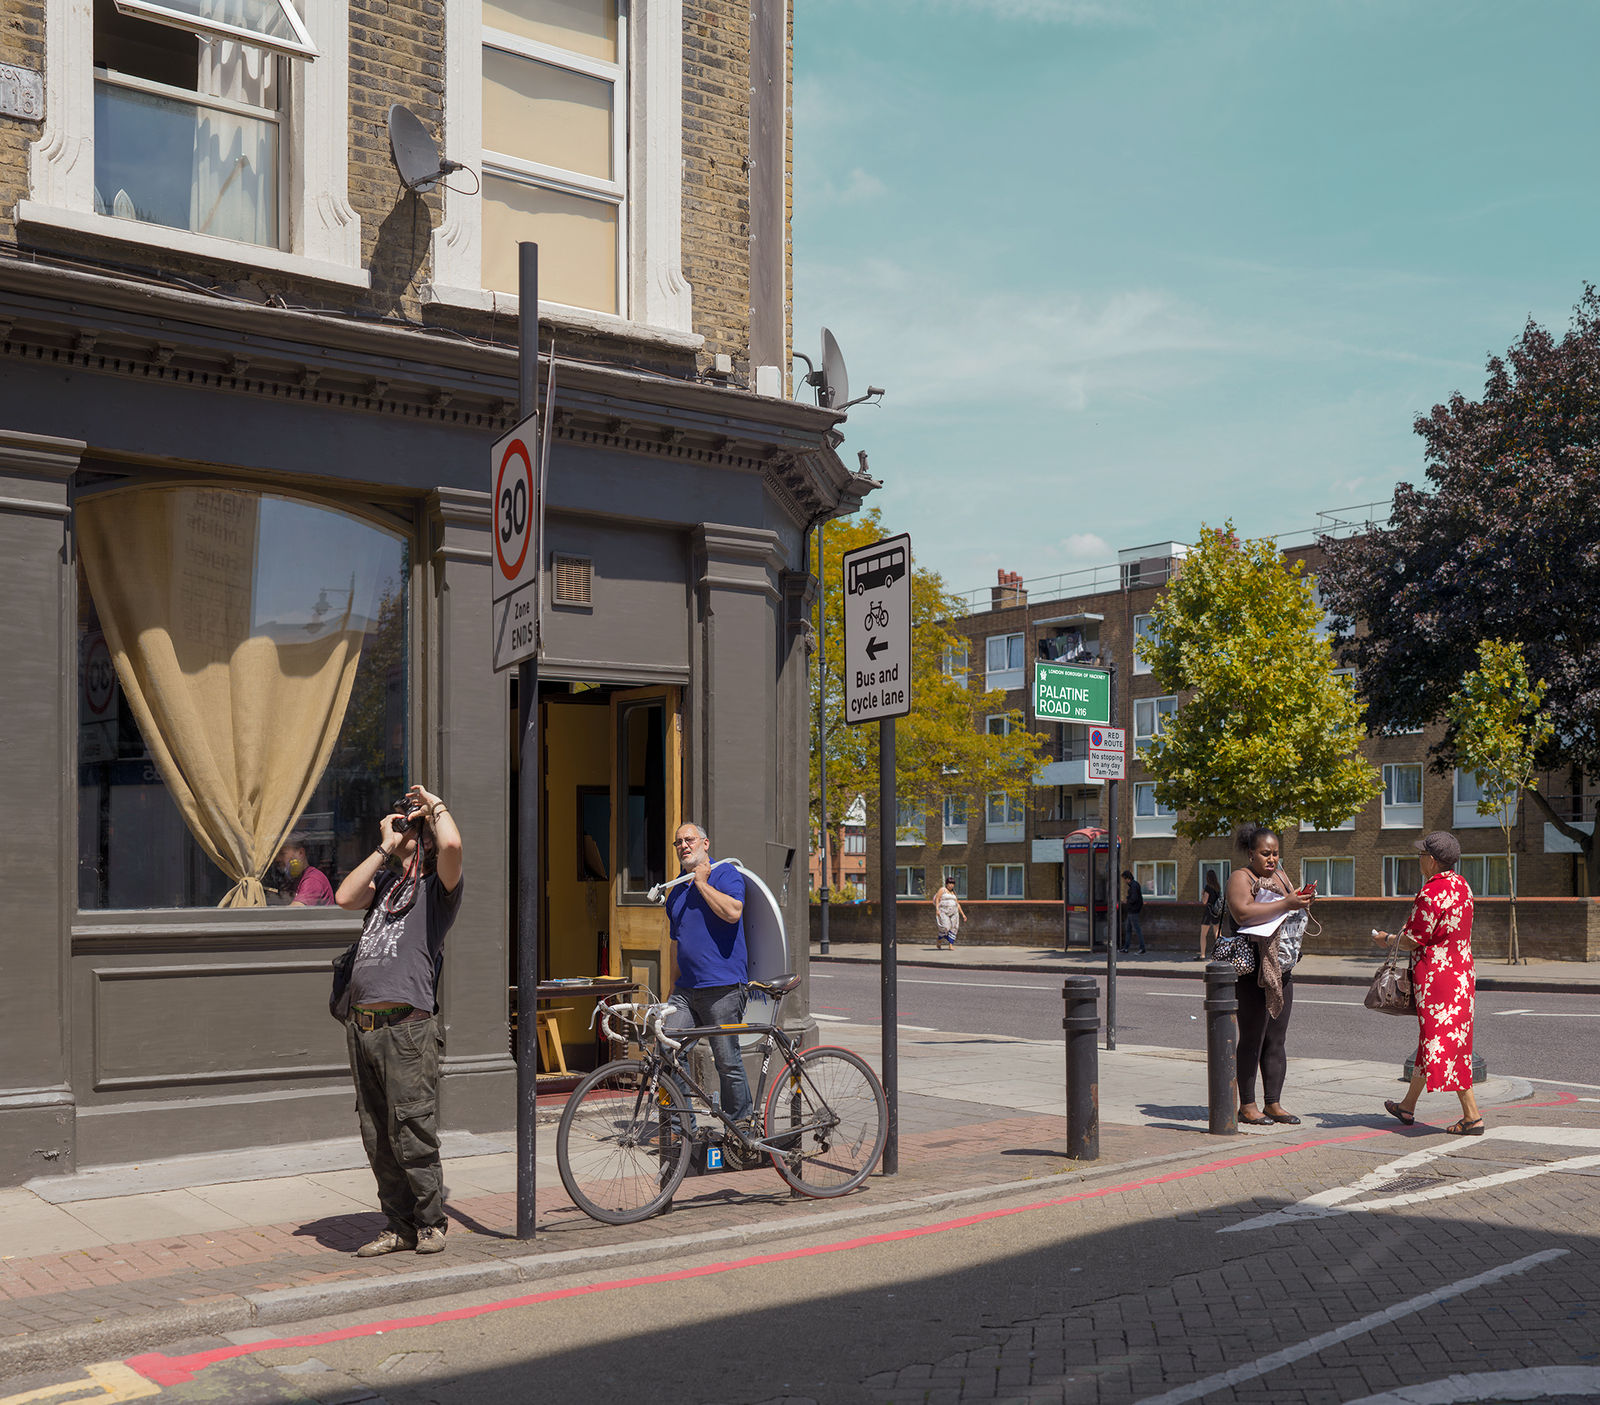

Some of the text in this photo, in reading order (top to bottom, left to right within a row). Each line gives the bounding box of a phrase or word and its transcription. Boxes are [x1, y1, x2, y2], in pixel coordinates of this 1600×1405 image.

[501, 478, 526, 544] 30
[514, 602, 530, 621] Zone
[512, 621, 533, 651] ENDS
[856, 663, 898, 688] Bus and
[851, 688, 904, 714] cycle lane
[1039, 684, 1089, 702] PALATINE
[1039, 699, 1087, 717] ROAD N16
[1103, 740, 1123, 748] ROUTE
[1091, 752, 1123, 762] No stopping
[1110, 761, 1120, 770] day
[1095, 768, 1119, 776] 7am-7pm
[711, 1150, 721, 1166] P
